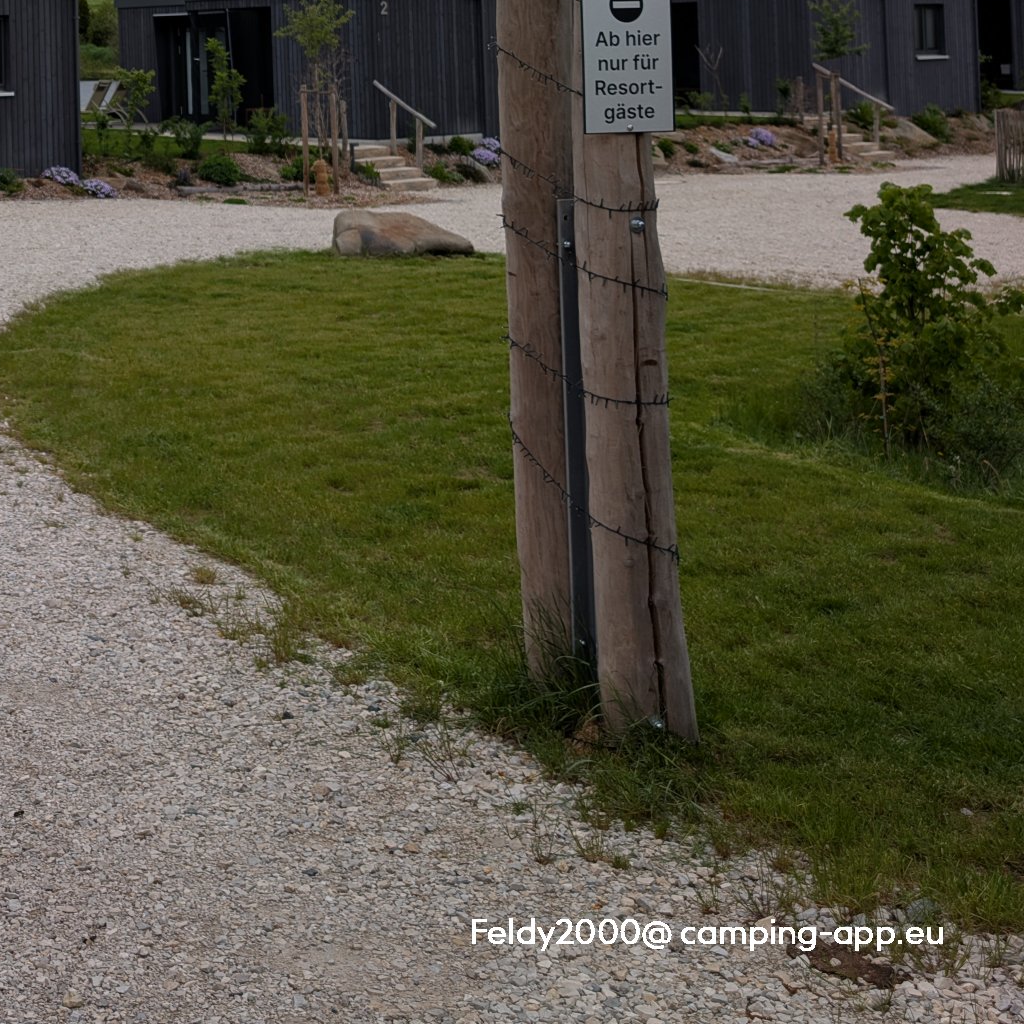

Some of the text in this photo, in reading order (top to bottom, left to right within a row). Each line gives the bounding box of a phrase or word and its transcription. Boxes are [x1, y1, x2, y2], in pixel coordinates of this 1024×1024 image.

[380, 1, 388, 15] 2
[595, 30, 660, 47] Ab hier
[598, 54, 659, 71] nur für
[595, 79, 663, 96] Resort-
[604, 103, 655, 124] gäste
